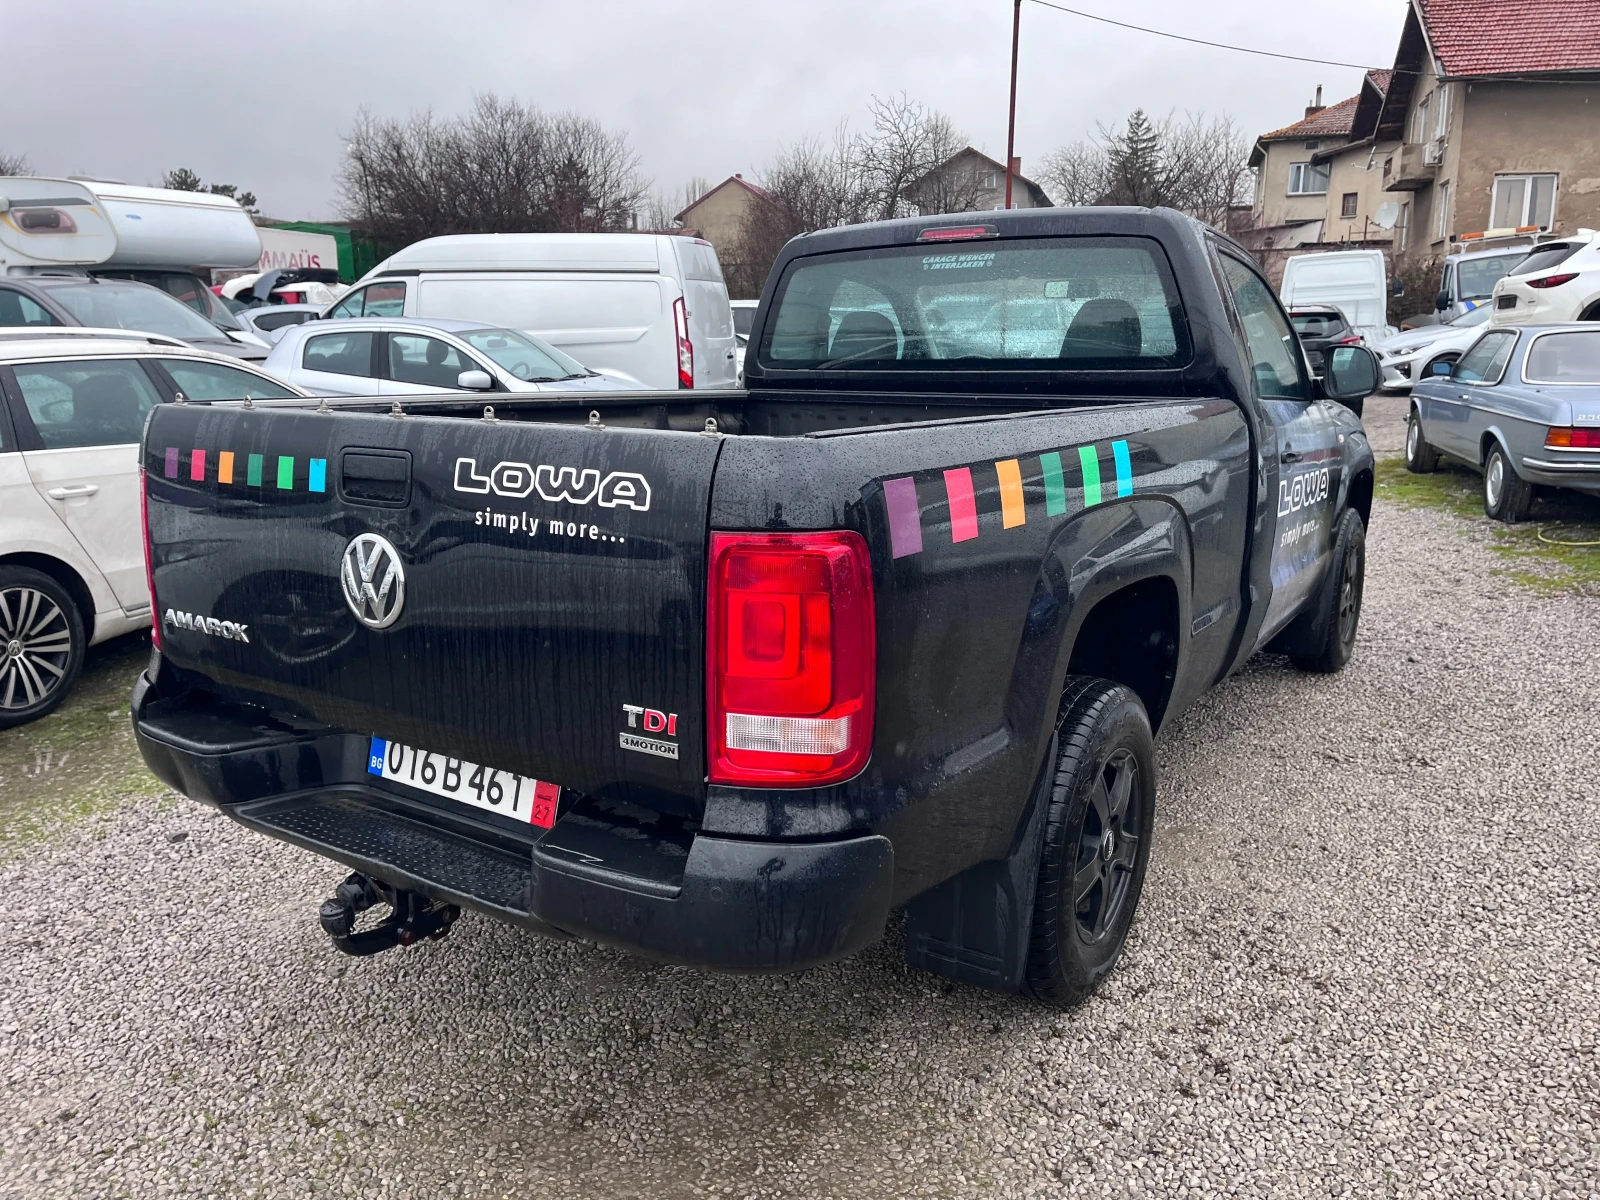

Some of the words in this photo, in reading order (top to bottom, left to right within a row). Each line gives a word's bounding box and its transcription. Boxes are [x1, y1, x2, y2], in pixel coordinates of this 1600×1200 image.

[922, 255, 956, 264] GARAGE
[958, 253, 996, 262] WENGER
[930, 260, 985, 270] INTERLAKEN
[454, 457, 651, 511] LOWA
[1278, 467, 1329, 517] LOWA
[475, 507, 539, 536] simply
[550, 519, 625, 543] more...
[1281, 522, 1301, 548] simply
[164, 608, 250, 643] AMAROK
[623, 704, 678, 736] TDI
[622, 738, 676, 755] 4MOTION
[371, 756, 383, 769] BG
[534, 804, 551, 821] 27
